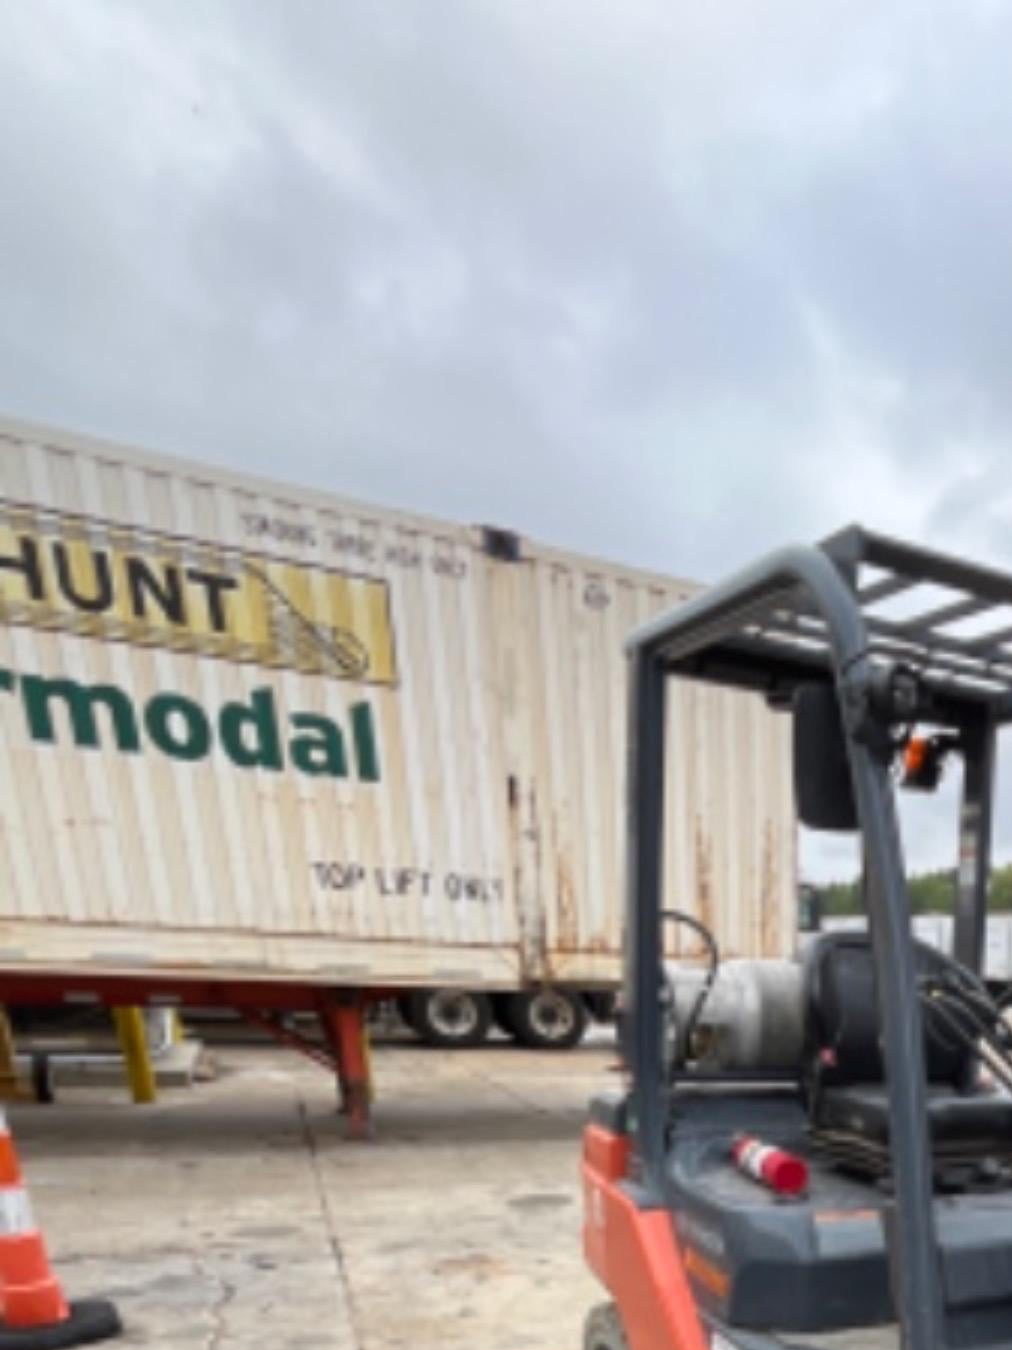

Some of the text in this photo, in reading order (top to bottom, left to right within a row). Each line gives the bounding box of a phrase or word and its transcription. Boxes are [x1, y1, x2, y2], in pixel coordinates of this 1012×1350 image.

[0, 536, 238, 633] HUNT
[311, 861, 365, 892] TOP
[374, 865, 431, 896] LIFT
